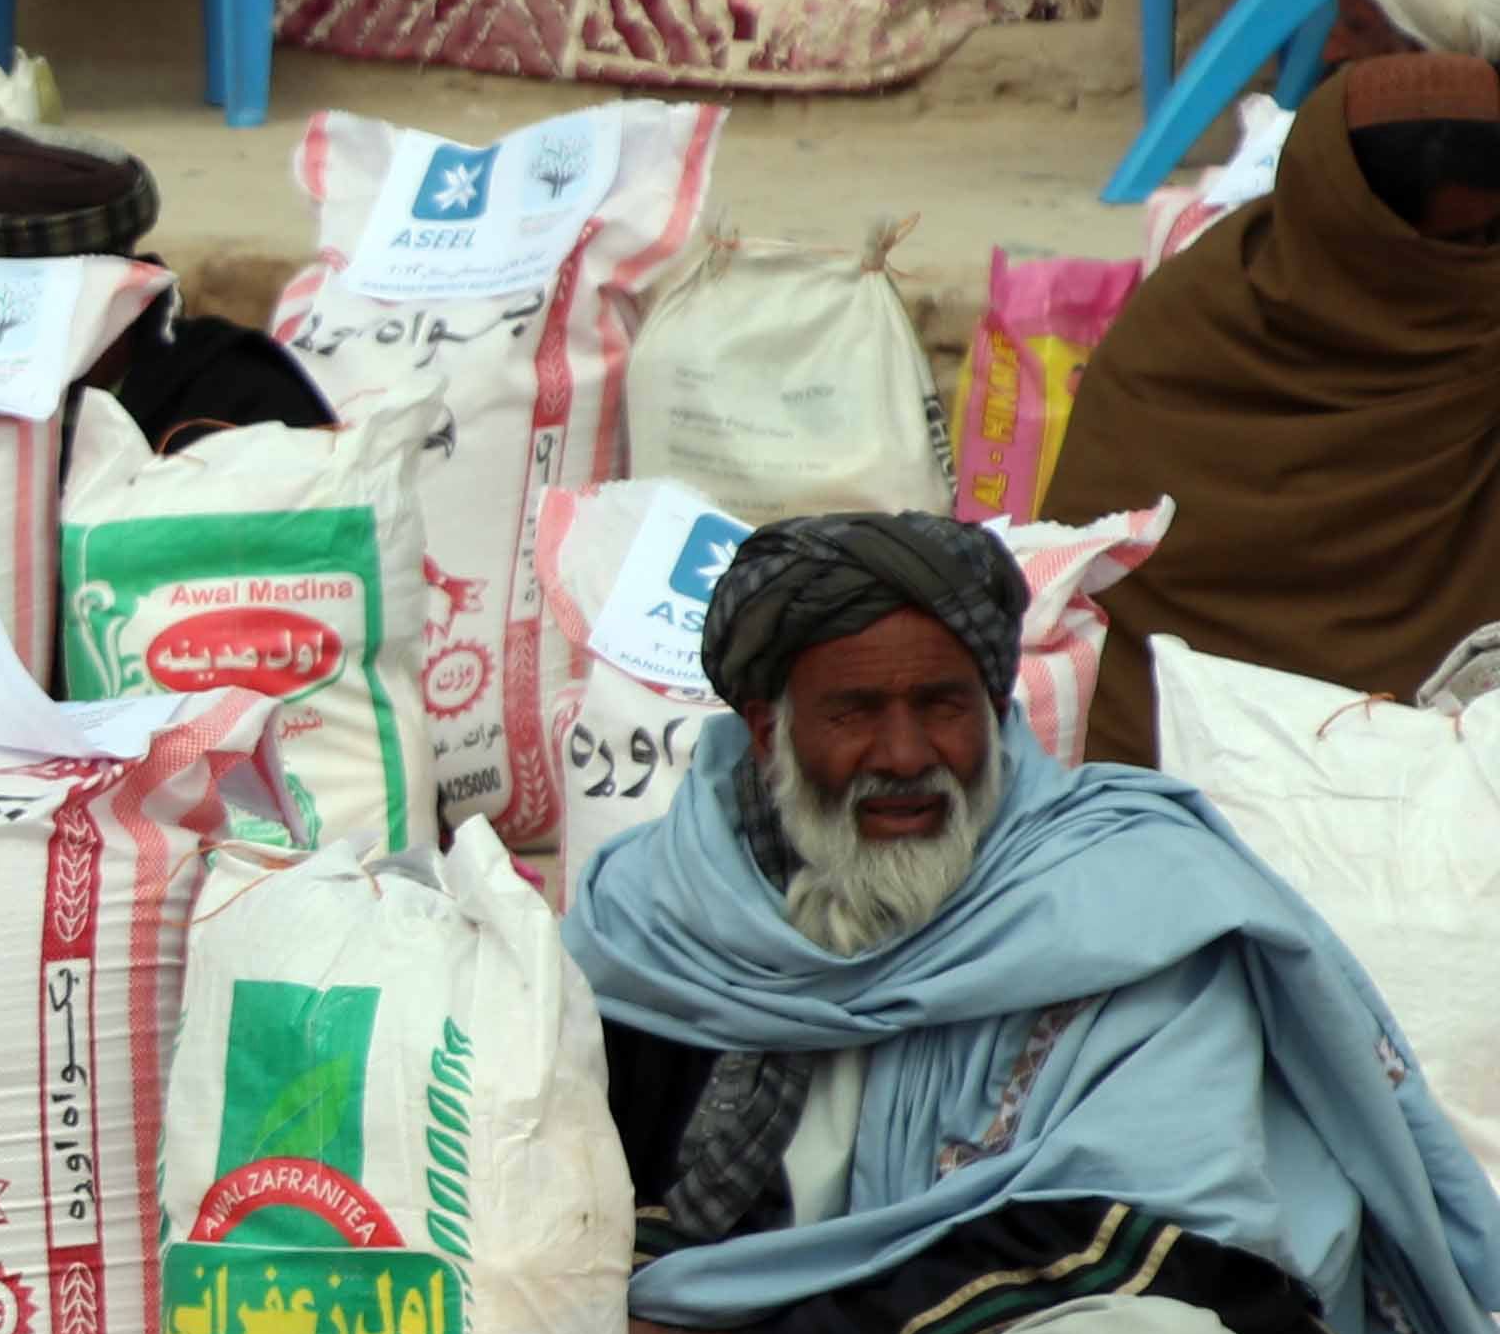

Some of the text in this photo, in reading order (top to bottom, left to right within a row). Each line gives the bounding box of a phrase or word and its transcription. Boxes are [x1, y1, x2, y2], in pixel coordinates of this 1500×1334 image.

[170, 578, 354, 607] Awal Madina
[155, 628, 325, 681] اول مدینه
[620, 653, 707, 681] KANDAHA
[202, 1169, 380, 1247] AWAL ZAFRANI TEA
